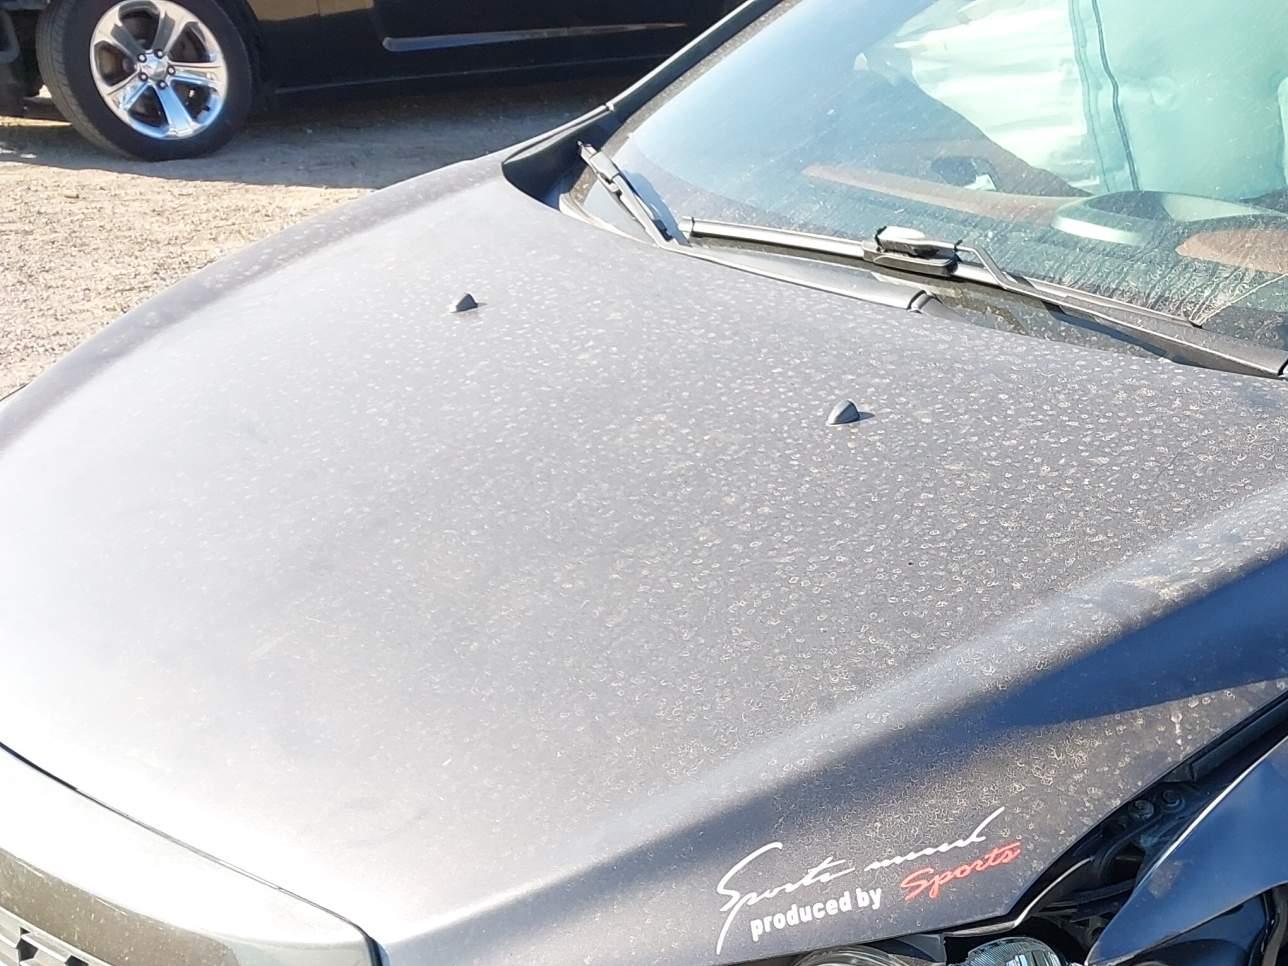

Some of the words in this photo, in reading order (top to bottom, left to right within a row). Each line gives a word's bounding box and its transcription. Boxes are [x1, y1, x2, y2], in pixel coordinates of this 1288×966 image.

[749, 890, 852, 942] produced
[855, 886, 883, 910] by
[899, 841, 1022, 902] Sports
